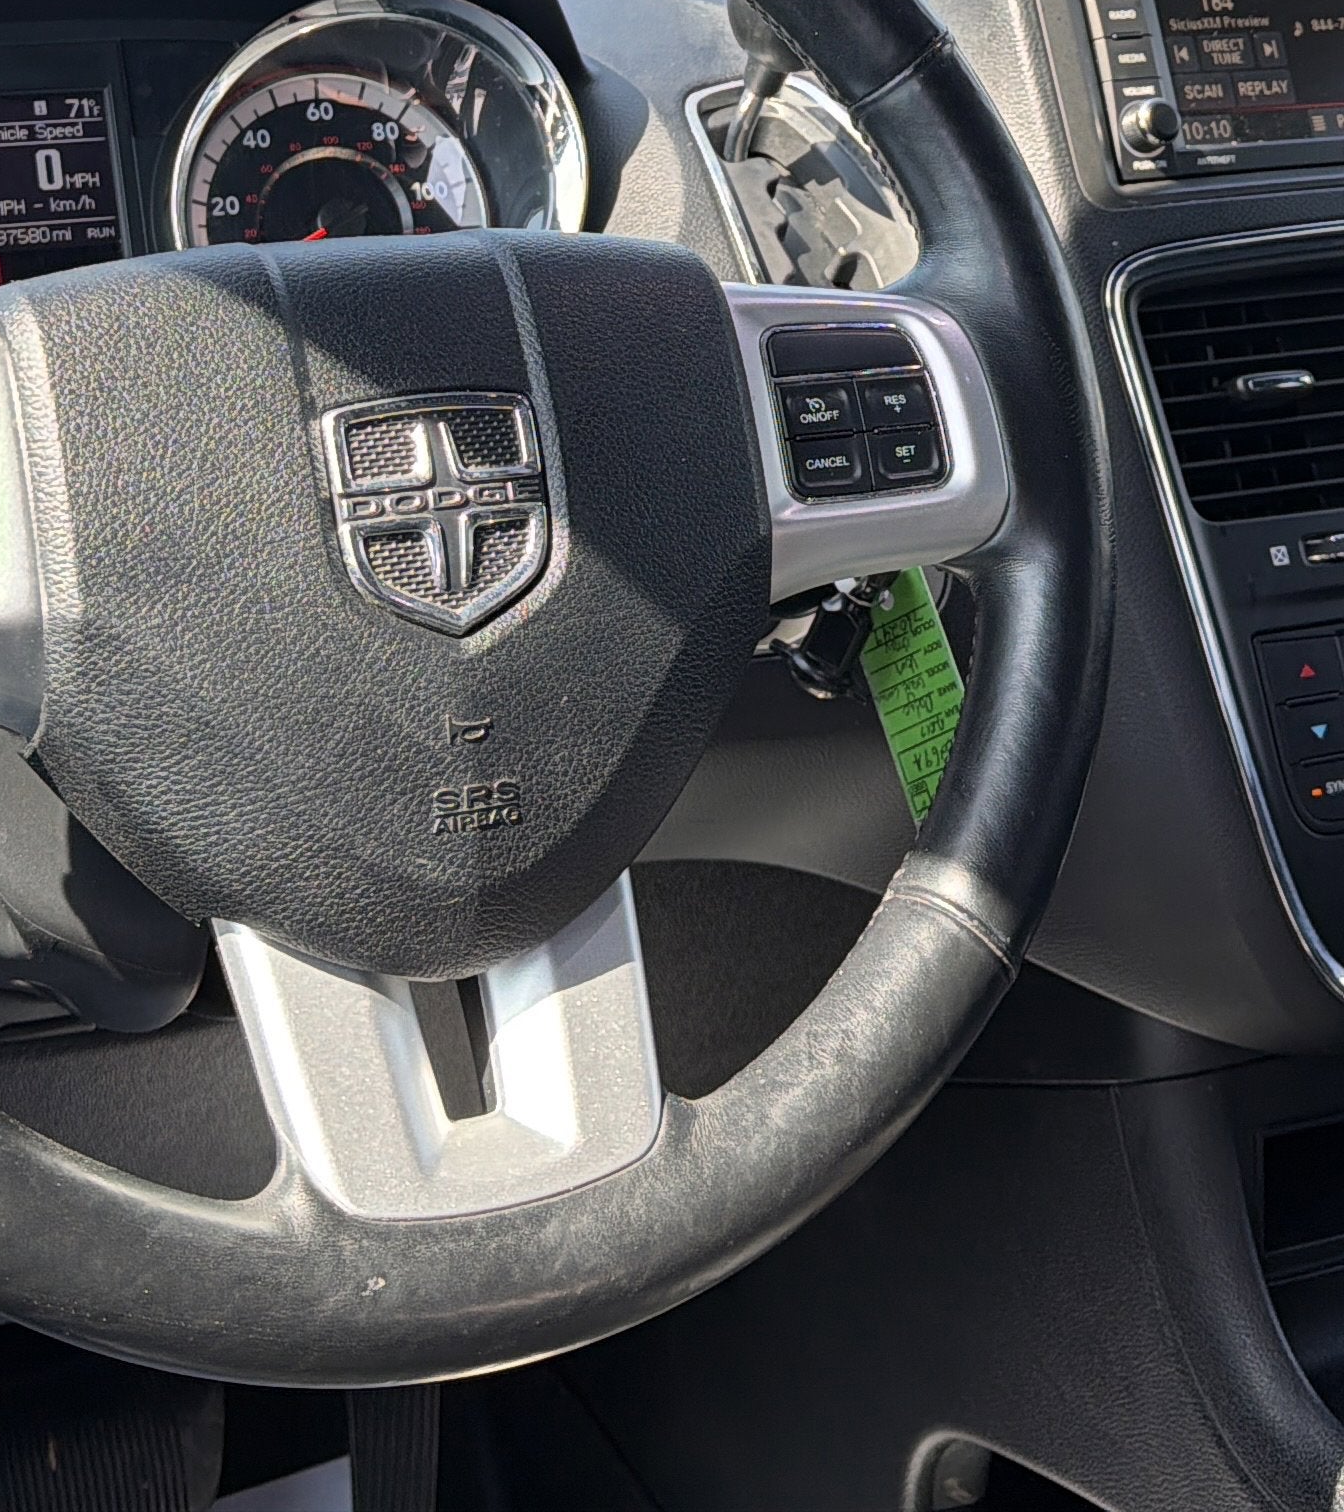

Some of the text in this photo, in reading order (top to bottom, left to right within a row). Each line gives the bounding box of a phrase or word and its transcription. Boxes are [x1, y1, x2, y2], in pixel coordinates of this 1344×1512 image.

[1202, 38, 1244, 53] DIRECT
[1212, 51, 1244, 65] TUNE
[1184, 83, 1223, 100] SCAN
[1237, 80, 1288, 97] REPLAY
[306, 101, 334, 122] 60
[34, 121, 84, 142] Speed
[371, 121, 399, 141] 80
[1182, 119, 1232, 140] 10:10
[242, 128, 271, 149] 40
[323, 136, 339, 144] 100
[356, 142, 373, 150] 120
[35, 148, 100, 191] 0 MPH
[260, 165, 273, 173] 60
[410, 181, 448, 201] 100
[49, 195, 96, 213] km/h
[211, 196, 240, 217] 20
[87, 227, 115, 239] RUN
[884, 394, 906, 406] RES
[799, 409, 840, 425] ON/OFF
[895, 444, 916, 458] SET
[806, 455, 850, 470] CANCEL
[341, 479, 542, 520] DODGE
[432, 779, 521, 810] SRS
[432, 806, 523, 834] AIRBAG
